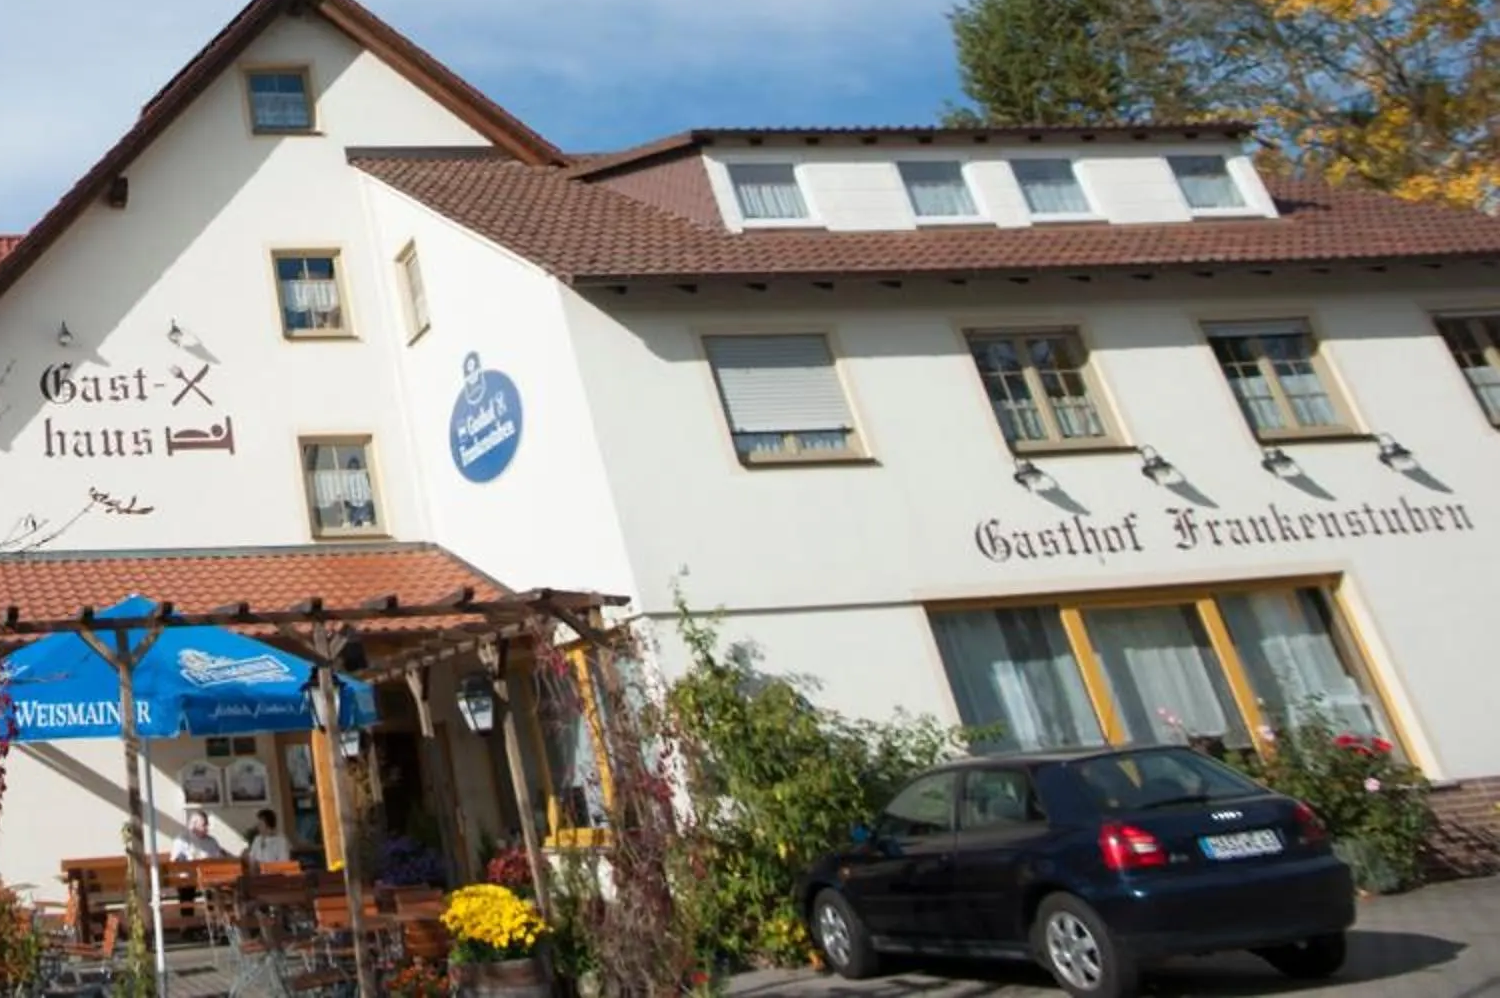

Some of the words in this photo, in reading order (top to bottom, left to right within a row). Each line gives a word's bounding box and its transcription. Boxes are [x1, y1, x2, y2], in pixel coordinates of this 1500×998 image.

[43, 417, 153, 458] haus
[974, 512, 1145, 565] Gasthof
[1165, 496, 1476, 551] Frankenstuben
[15, 699, 152, 728] WEISMAINR
